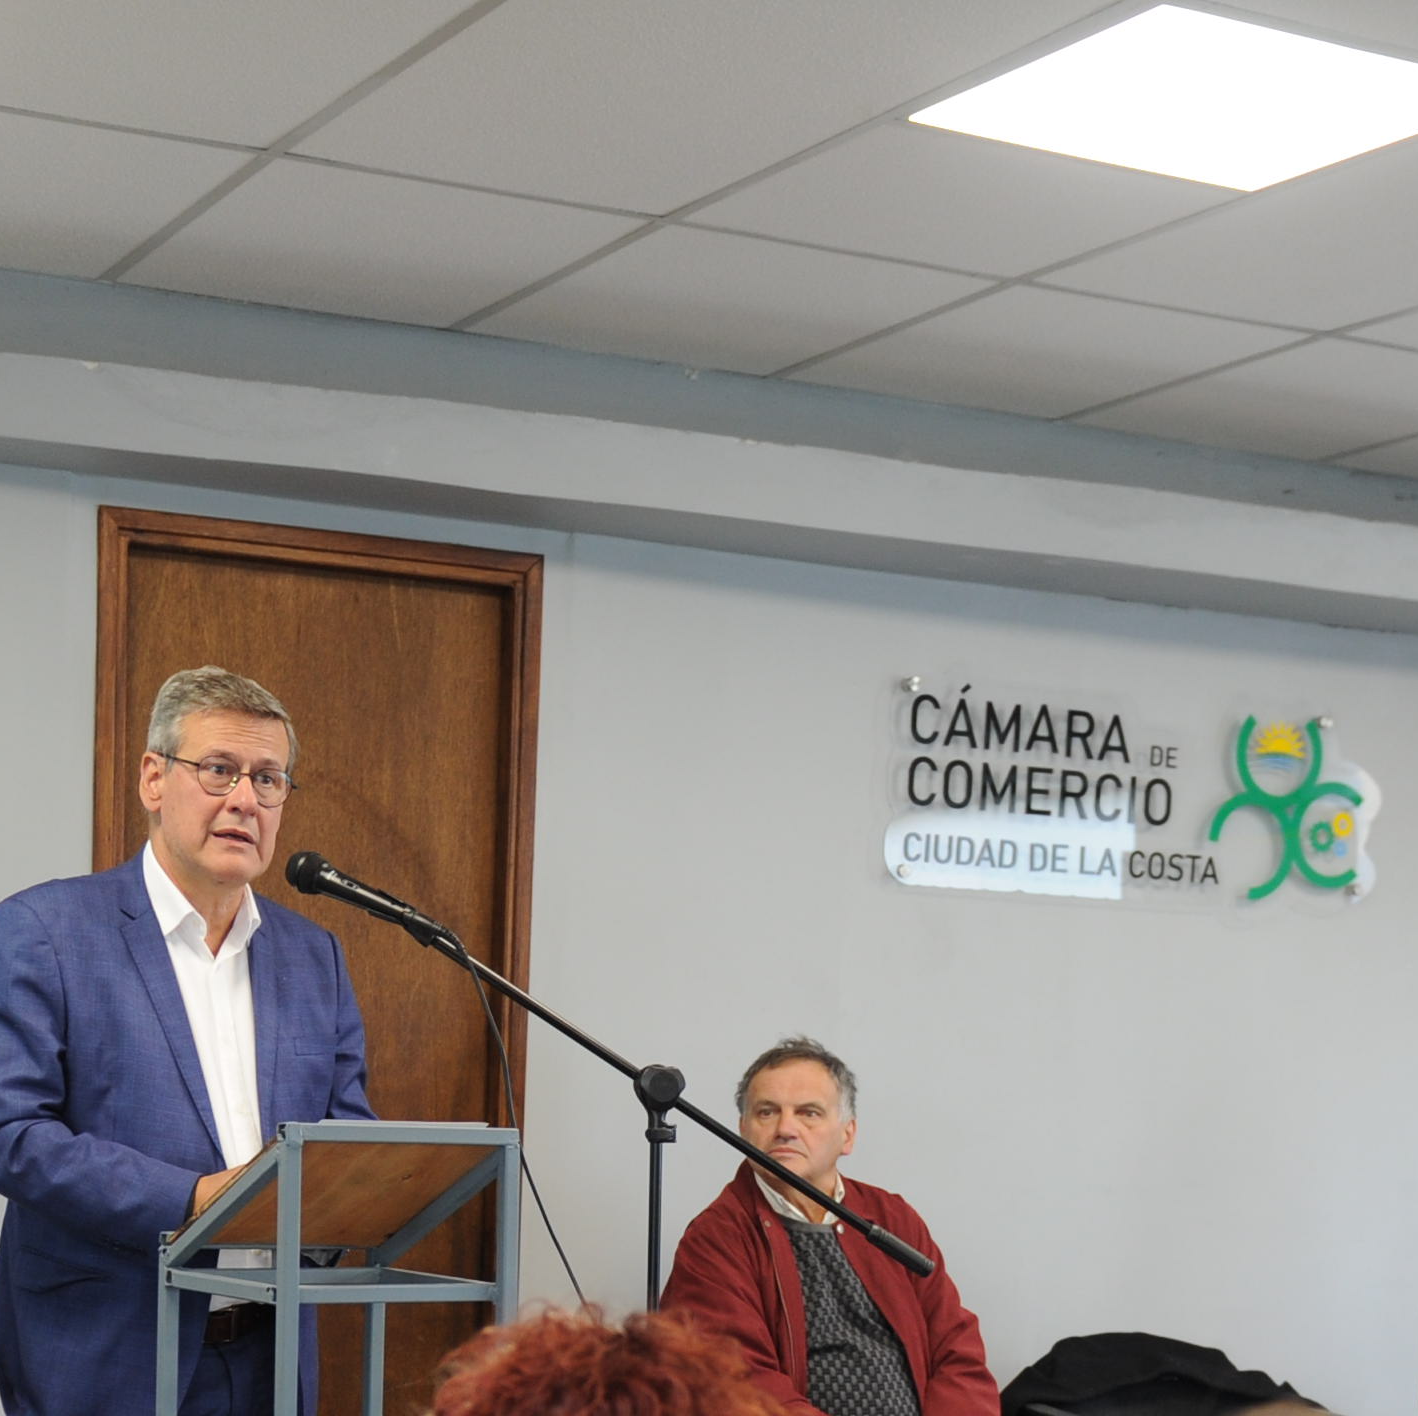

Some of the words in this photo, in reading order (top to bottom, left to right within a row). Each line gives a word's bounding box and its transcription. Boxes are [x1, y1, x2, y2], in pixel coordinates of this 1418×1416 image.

[910, 684, 1130, 764] CÁMARA
[1150, 746, 1178, 769] DE
[907, 756, 1172, 826] COMERCIO
[902, 832, 1017, 870] CIUDAD
[1028, 844, 1068, 874] DE
[1080, 846, 1117, 877] LA
[1128, 850, 1219, 886] COSTA
